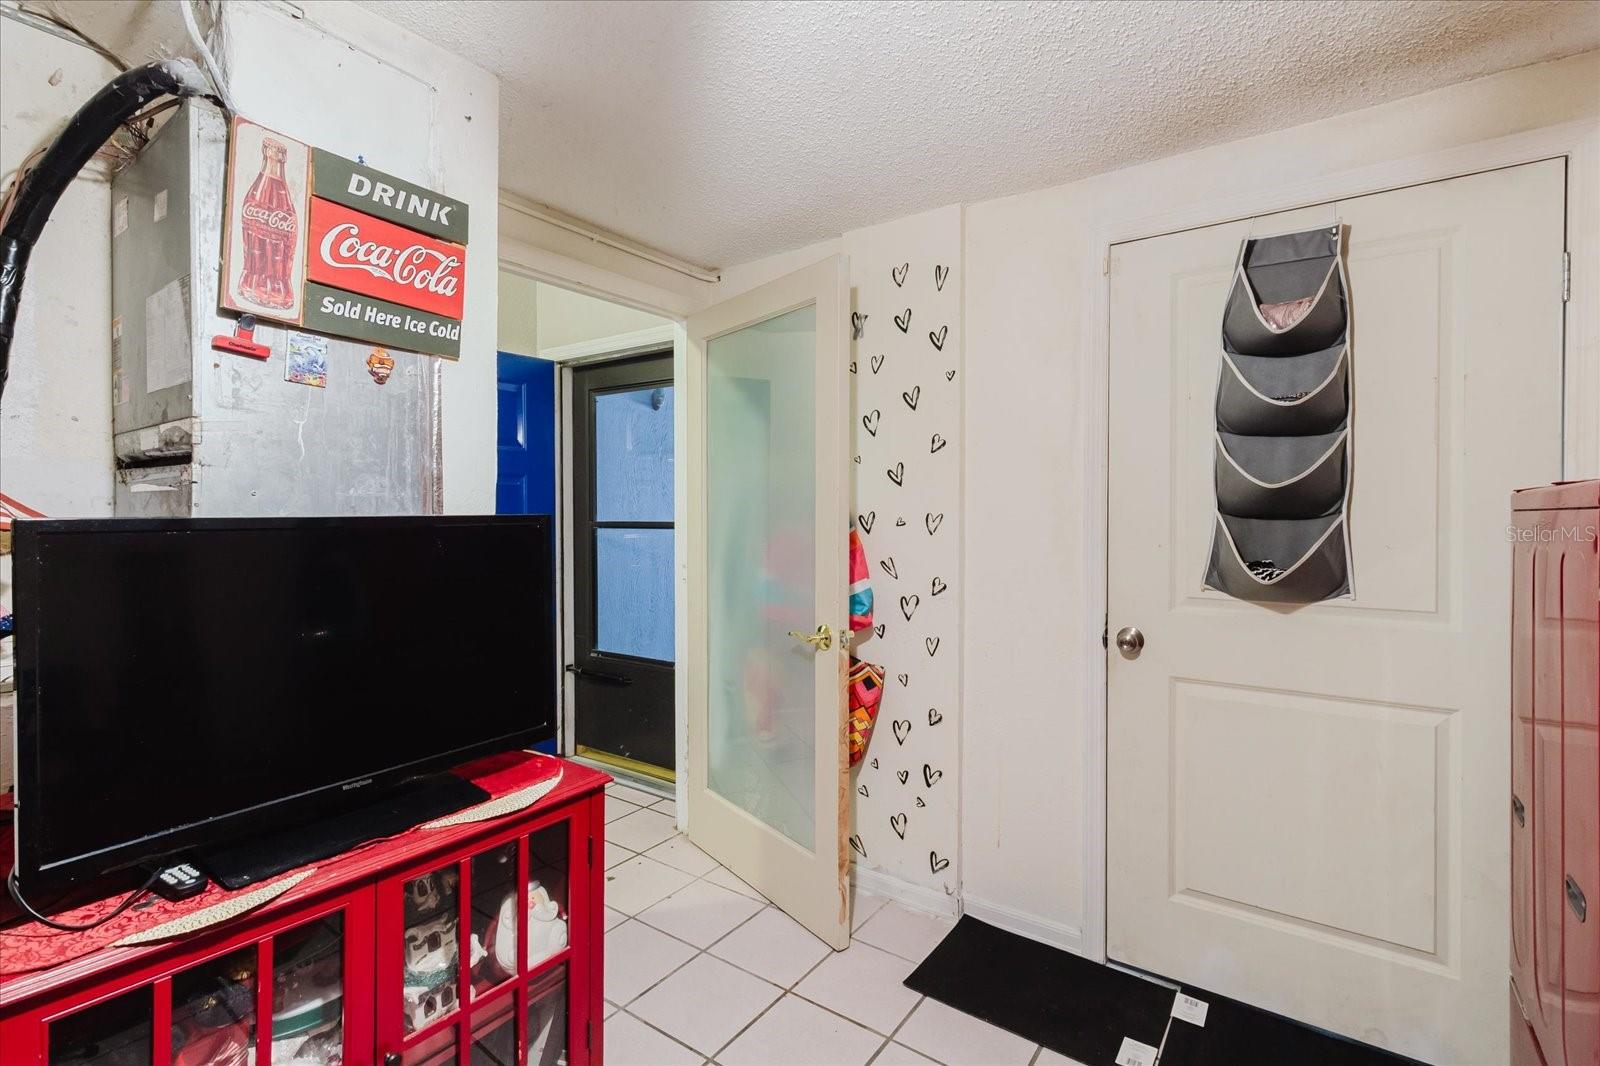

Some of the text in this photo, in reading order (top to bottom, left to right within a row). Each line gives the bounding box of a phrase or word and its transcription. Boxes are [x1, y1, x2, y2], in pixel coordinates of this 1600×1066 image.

[347, 172, 453, 226] DRINK
[320, 223, 462, 297] Coca-Cola
[320, 297, 461, 341] Sold Here Ice Cold
